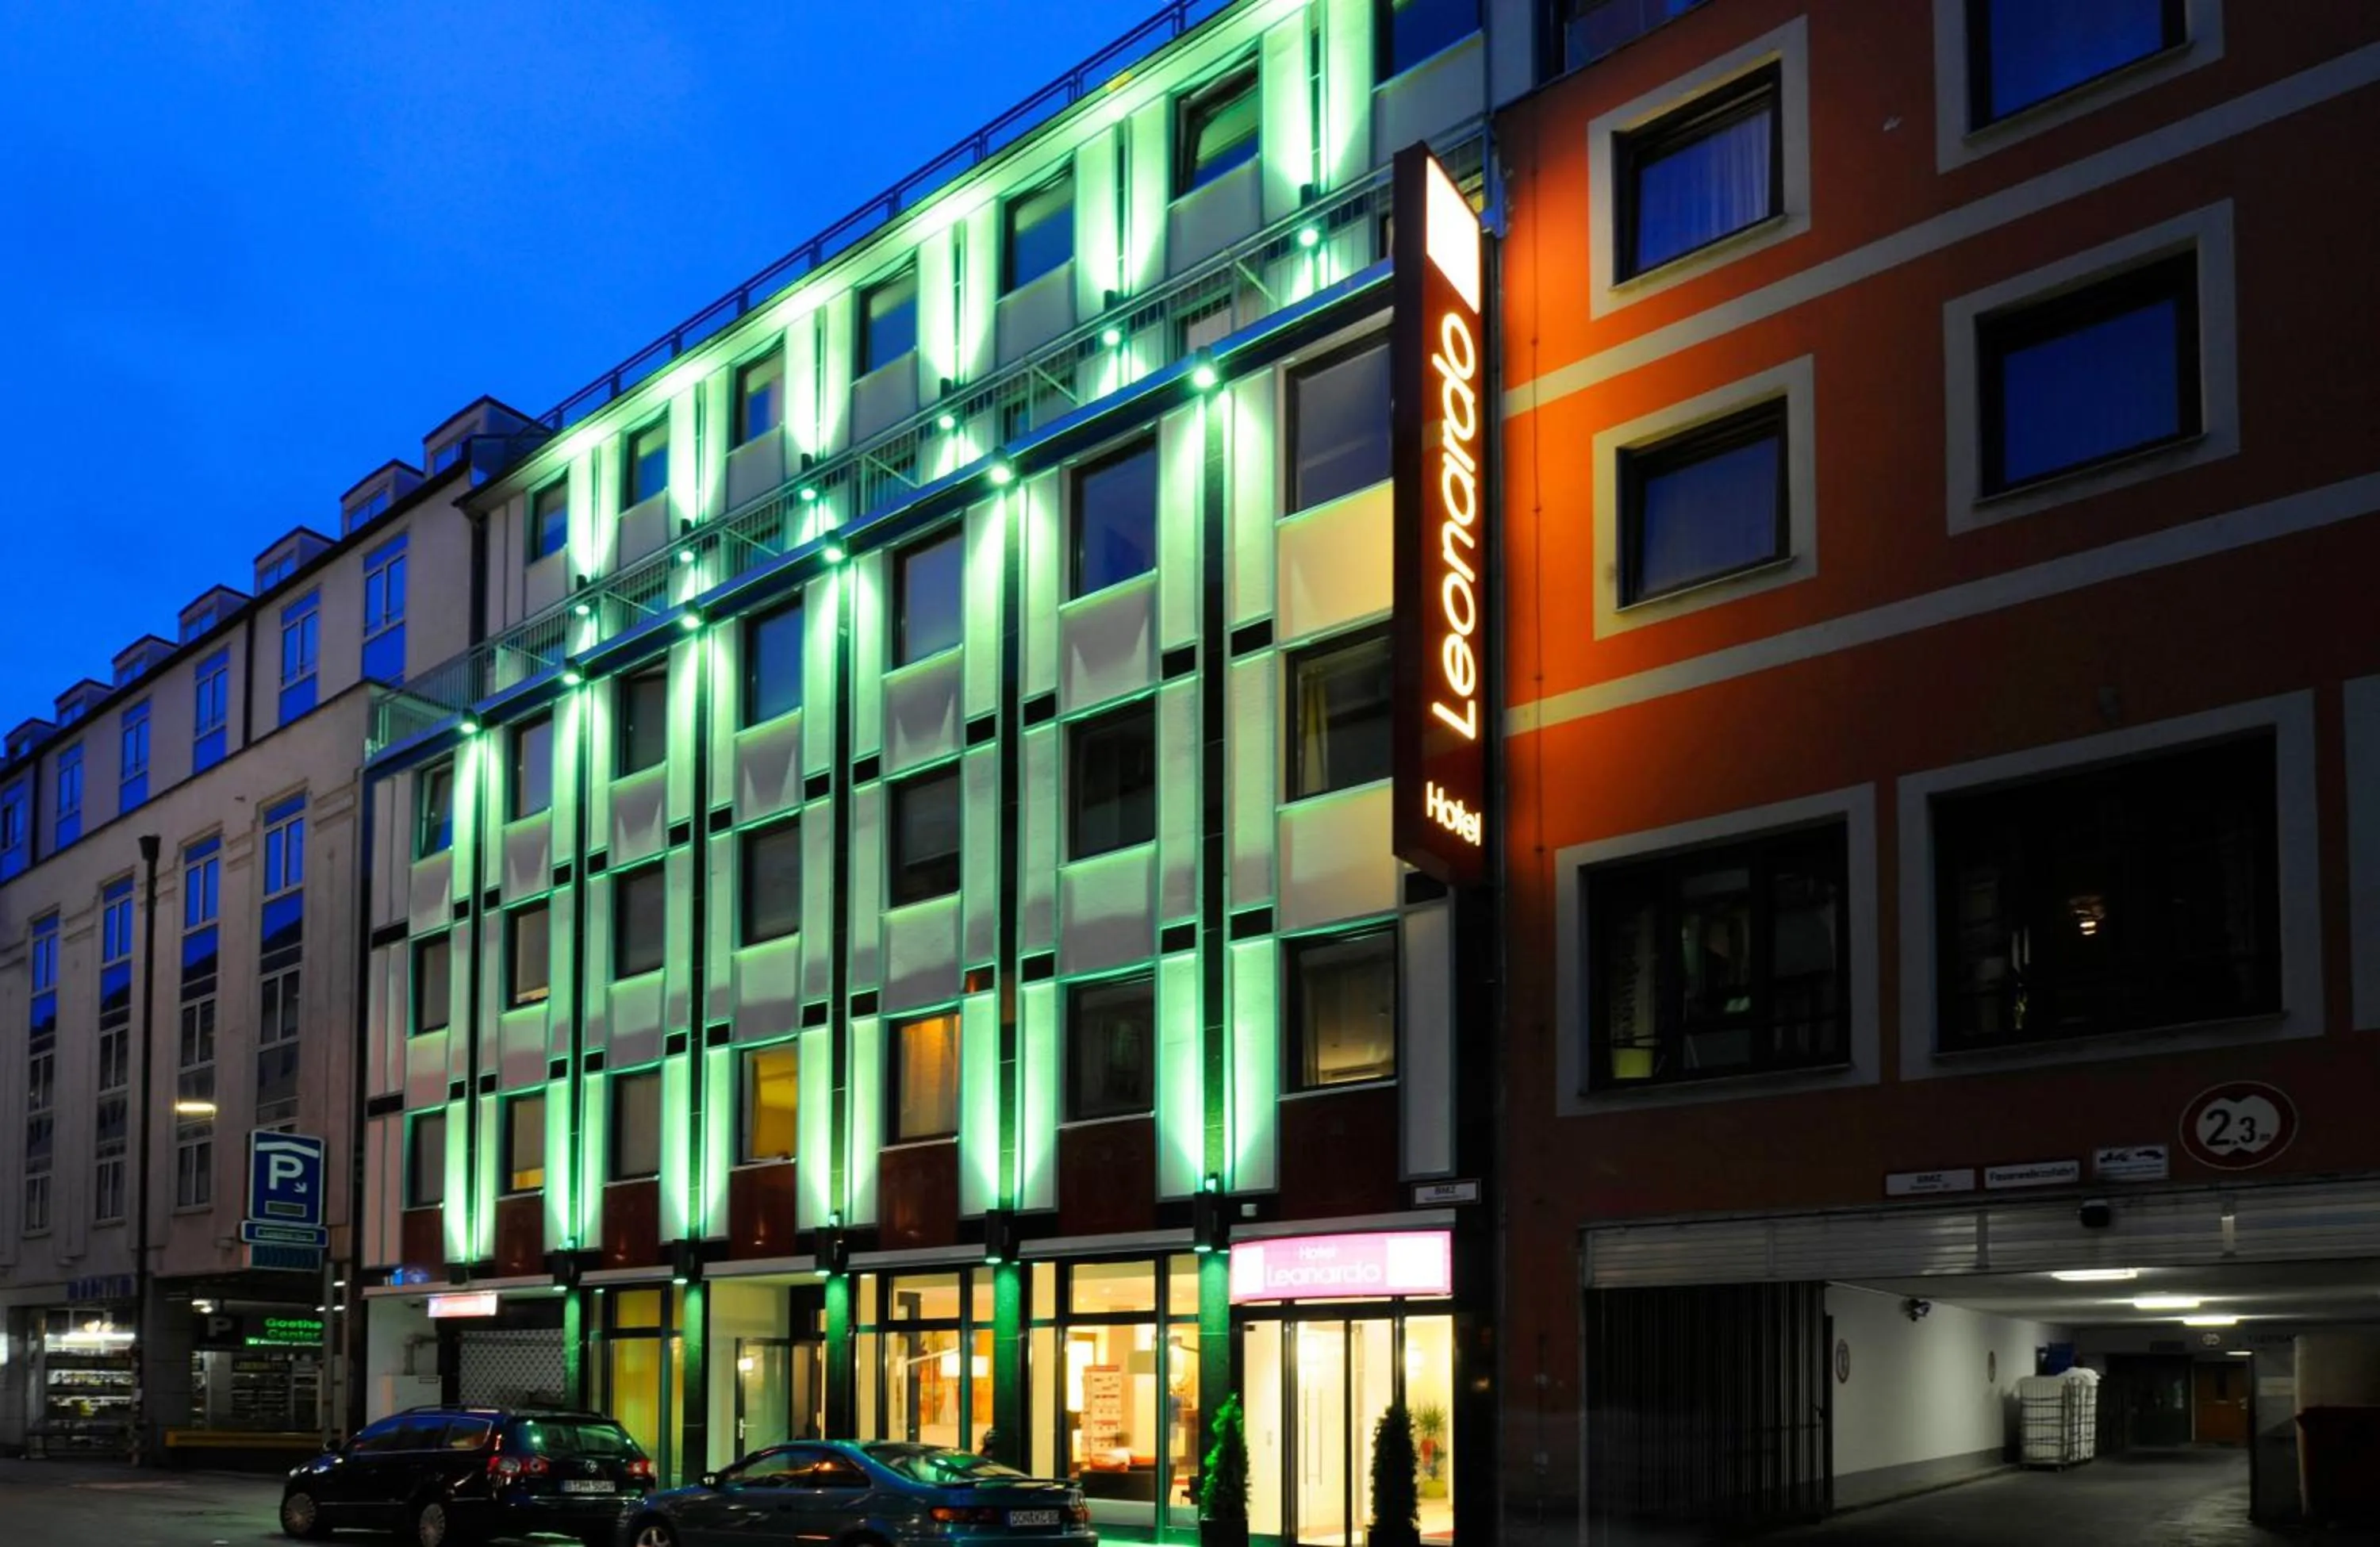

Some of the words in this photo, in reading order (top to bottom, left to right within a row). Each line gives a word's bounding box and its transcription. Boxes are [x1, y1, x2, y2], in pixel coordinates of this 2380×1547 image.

[1431, 312, 1477, 741] Leonardo
[1426, 781, 1481, 846] Hotel
[268, 1153, 305, 1191] P
[1298, 1245, 1338, 1261] Hotel
[1266, 1261, 1383, 1288] Leonardo
[207, 1316, 232, 1337] P
[264, 1317, 323, 1330] Goethe
[267, 1329, 321, 1340] Center
